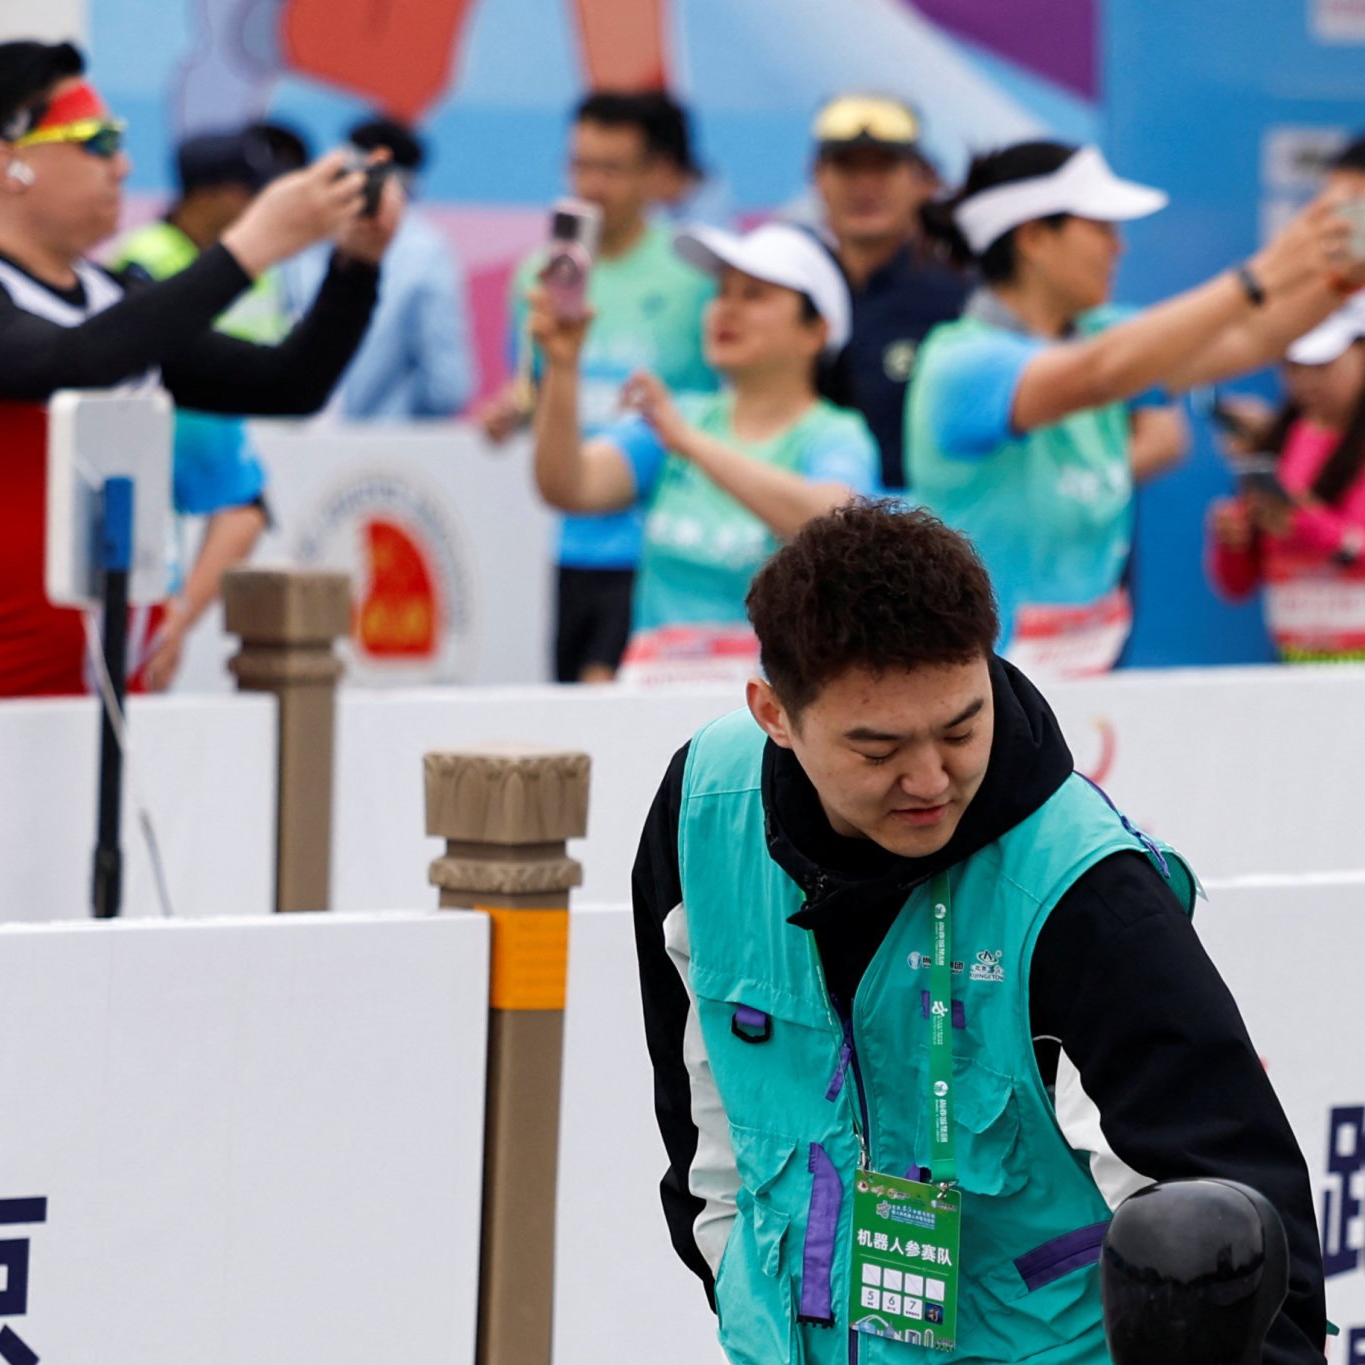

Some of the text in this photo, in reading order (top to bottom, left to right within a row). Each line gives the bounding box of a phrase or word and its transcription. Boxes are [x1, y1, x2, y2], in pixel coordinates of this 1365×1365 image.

[857, 1229, 952, 1267] 机器人参赛队
[867, 1290, 875, 1301] 5
[888, 1295, 896, 1306] 6
[909, 1300, 917, 1310] 7
